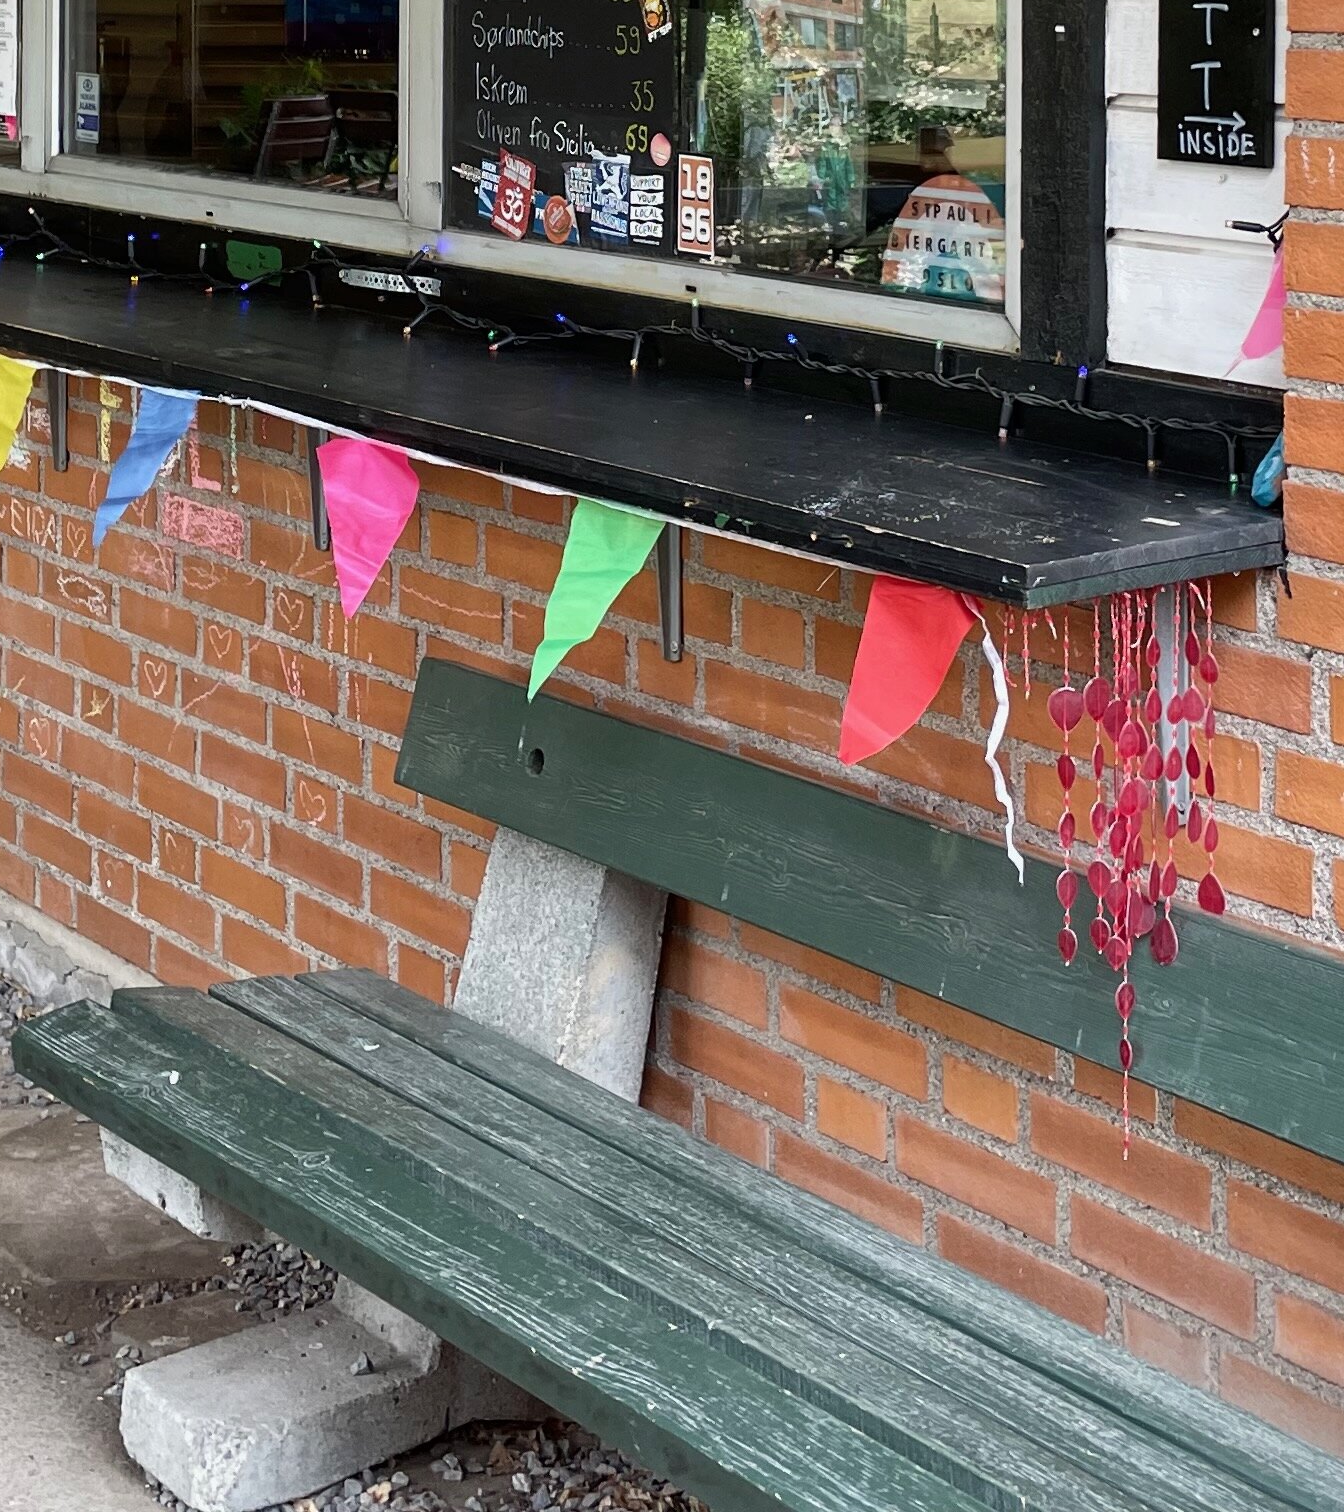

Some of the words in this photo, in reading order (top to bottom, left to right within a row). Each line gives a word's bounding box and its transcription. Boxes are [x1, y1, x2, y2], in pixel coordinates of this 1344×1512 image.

[615, 24, 641, 56] 59
[475, 61, 528, 106] Iskrem
[629, 79, 655, 112] 35
[476, 108, 521, 146] Oliven
[529, 116, 551, 152] fra
[553, 120, 595, 157] Sicilia
[626, 123, 649, 153] 69
[1177, 121, 1258, 160] INSIDE
[632, 176, 662, 188] SUPPORT
[636, 193, 657, 205] YOUR
[680, 162, 711, 202] 18
[634, 208, 659, 218] LOCAL
[680, 205, 711, 244] 96
